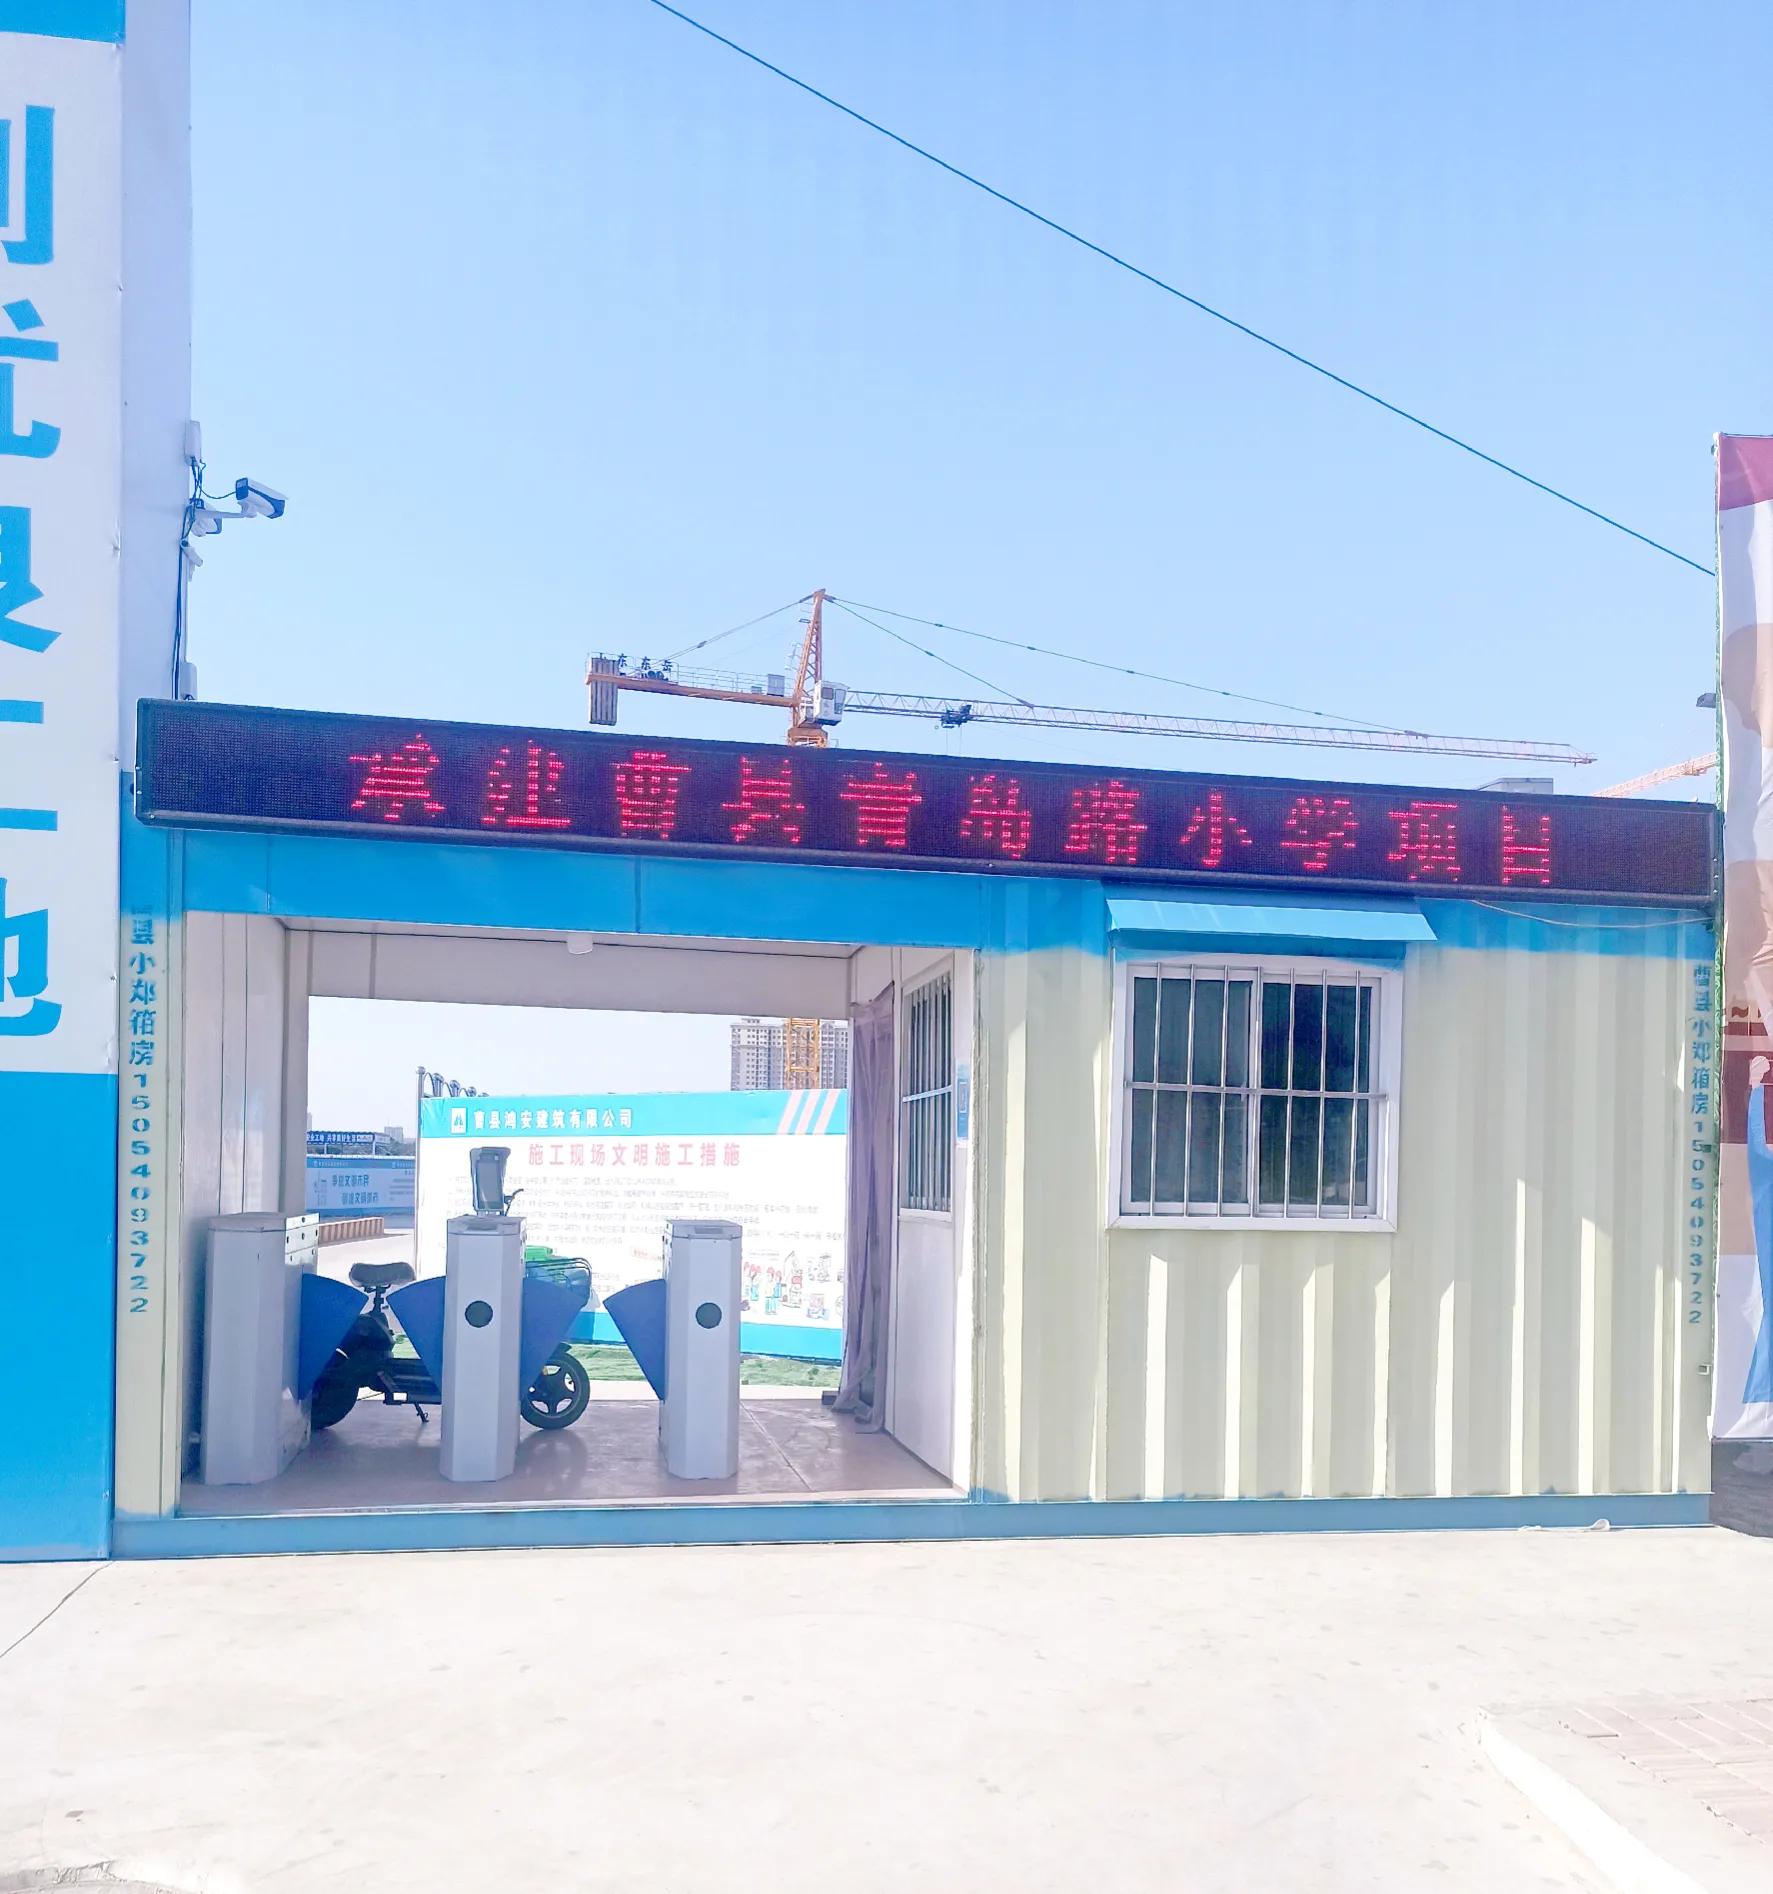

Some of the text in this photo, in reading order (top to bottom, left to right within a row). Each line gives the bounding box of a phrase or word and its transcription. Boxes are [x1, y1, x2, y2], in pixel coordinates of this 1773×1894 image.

[129, 904, 156, 1313] 县小郑箱房15054093722
[528, 1143, 742, 1167] 施工现场文明施工措施
